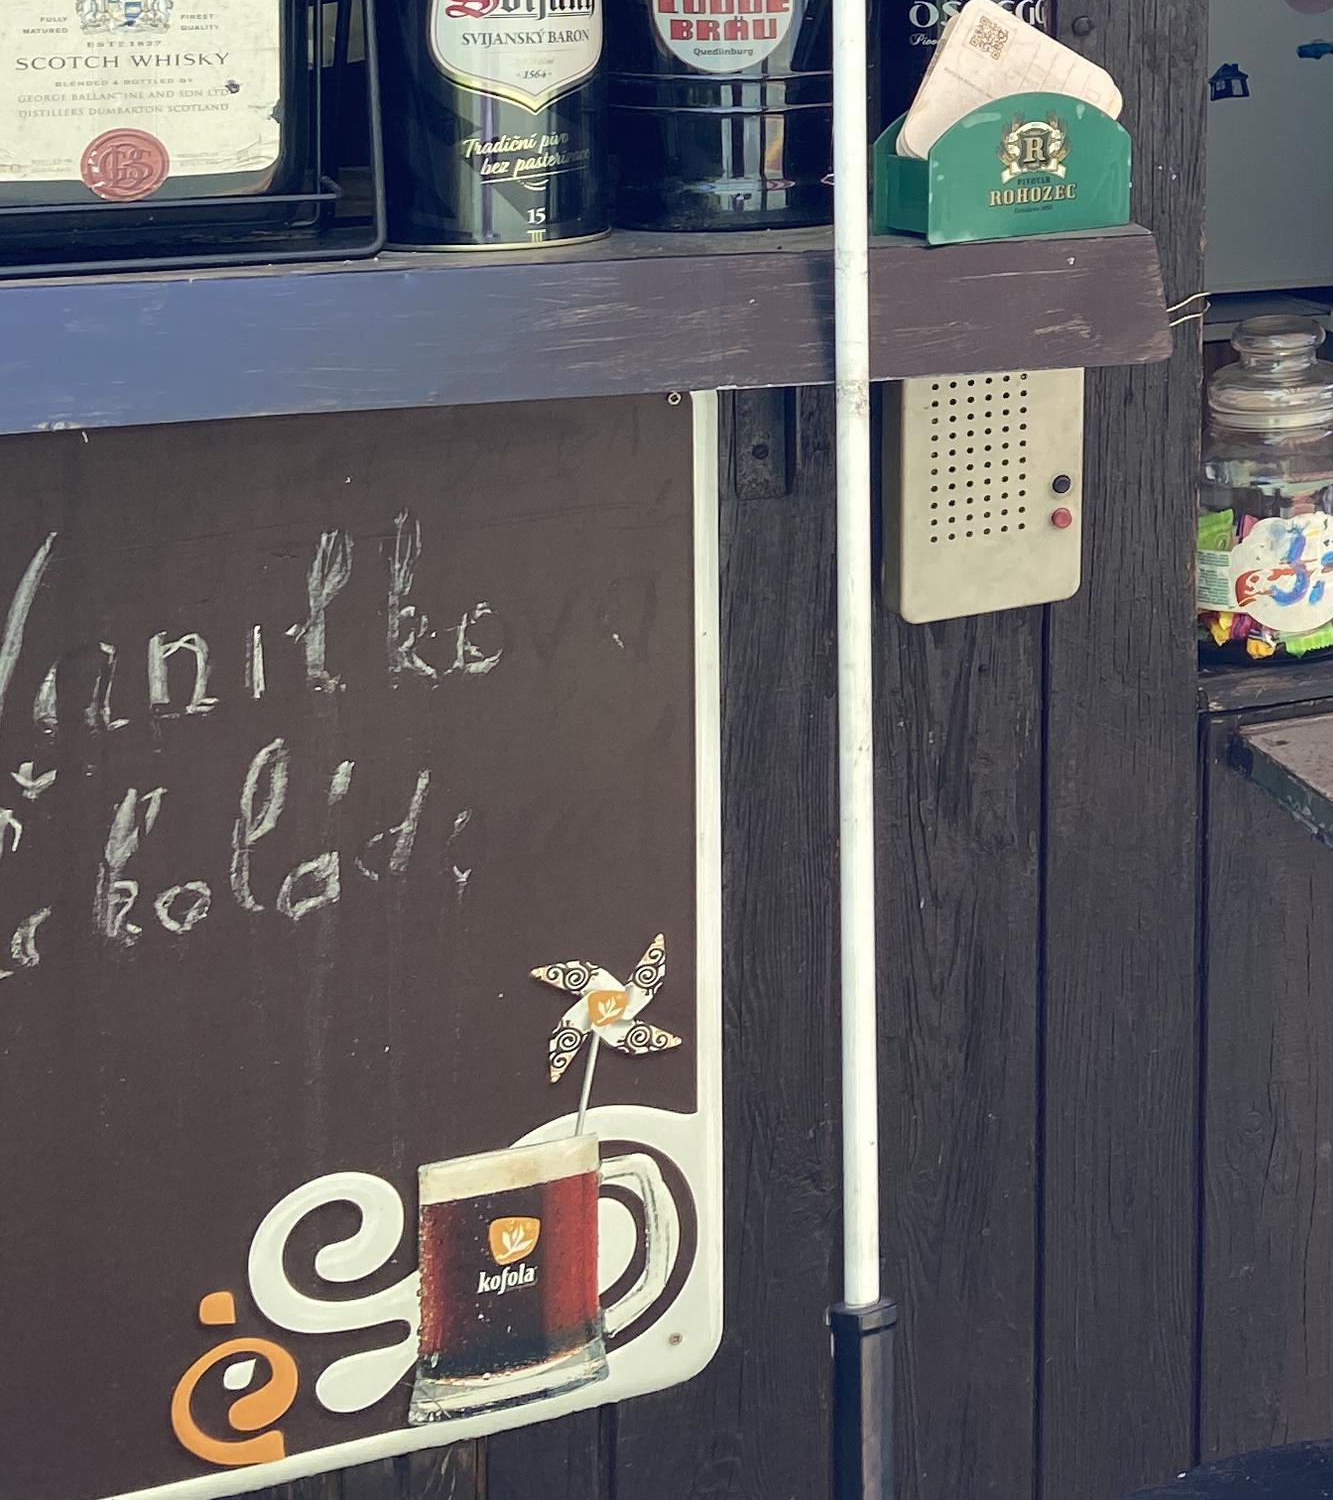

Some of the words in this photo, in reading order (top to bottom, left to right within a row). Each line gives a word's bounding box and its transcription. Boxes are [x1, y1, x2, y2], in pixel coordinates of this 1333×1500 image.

[39, 15, 68, 24] FULLY
[180, 13, 215, 21] FINEST
[22, 27, 69, 35] MATURED
[180, 24, 220, 32] QUALITY
[670, 17, 777, 42] BRÄU
[130, 39, 162, 47] 1827
[462, 28, 546, 50] SVIJANSKÝ
[547, 27, 591, 45] BARON
[693, 46, 754, 59] Quedlinburg
[15, 54, 119, 71] SCOTCH
[130, 52, 229, 68] WHISKY
[55, 79, 108, 88] BLENDED
[124, 78, 174, 87] BOTTLED
[522, 70, 547, 80] 1564
[18, 92, 66, 104] GEORGE
[149, 89, 174, 100] AND
[178, 88, 204, 98] SON
[208, 86, 229, 98] LTD
[18, 105, 85, 118] DISTILLERS
[88, 105, 164, 117] DUMBARTON
[168, 102, 229, 114] SCOTLAND
[462, 132, 537, 158] Tradiční
[539, 132, 569, 154] pivo
[1025, 136, 1046, 162] R
[481, 156, 508, 177] bez
[989, 184, 1078, 207] ROHOZEC
[527, 207, 546, 224] 15
[478, 1262, 538, 1295] kofola
